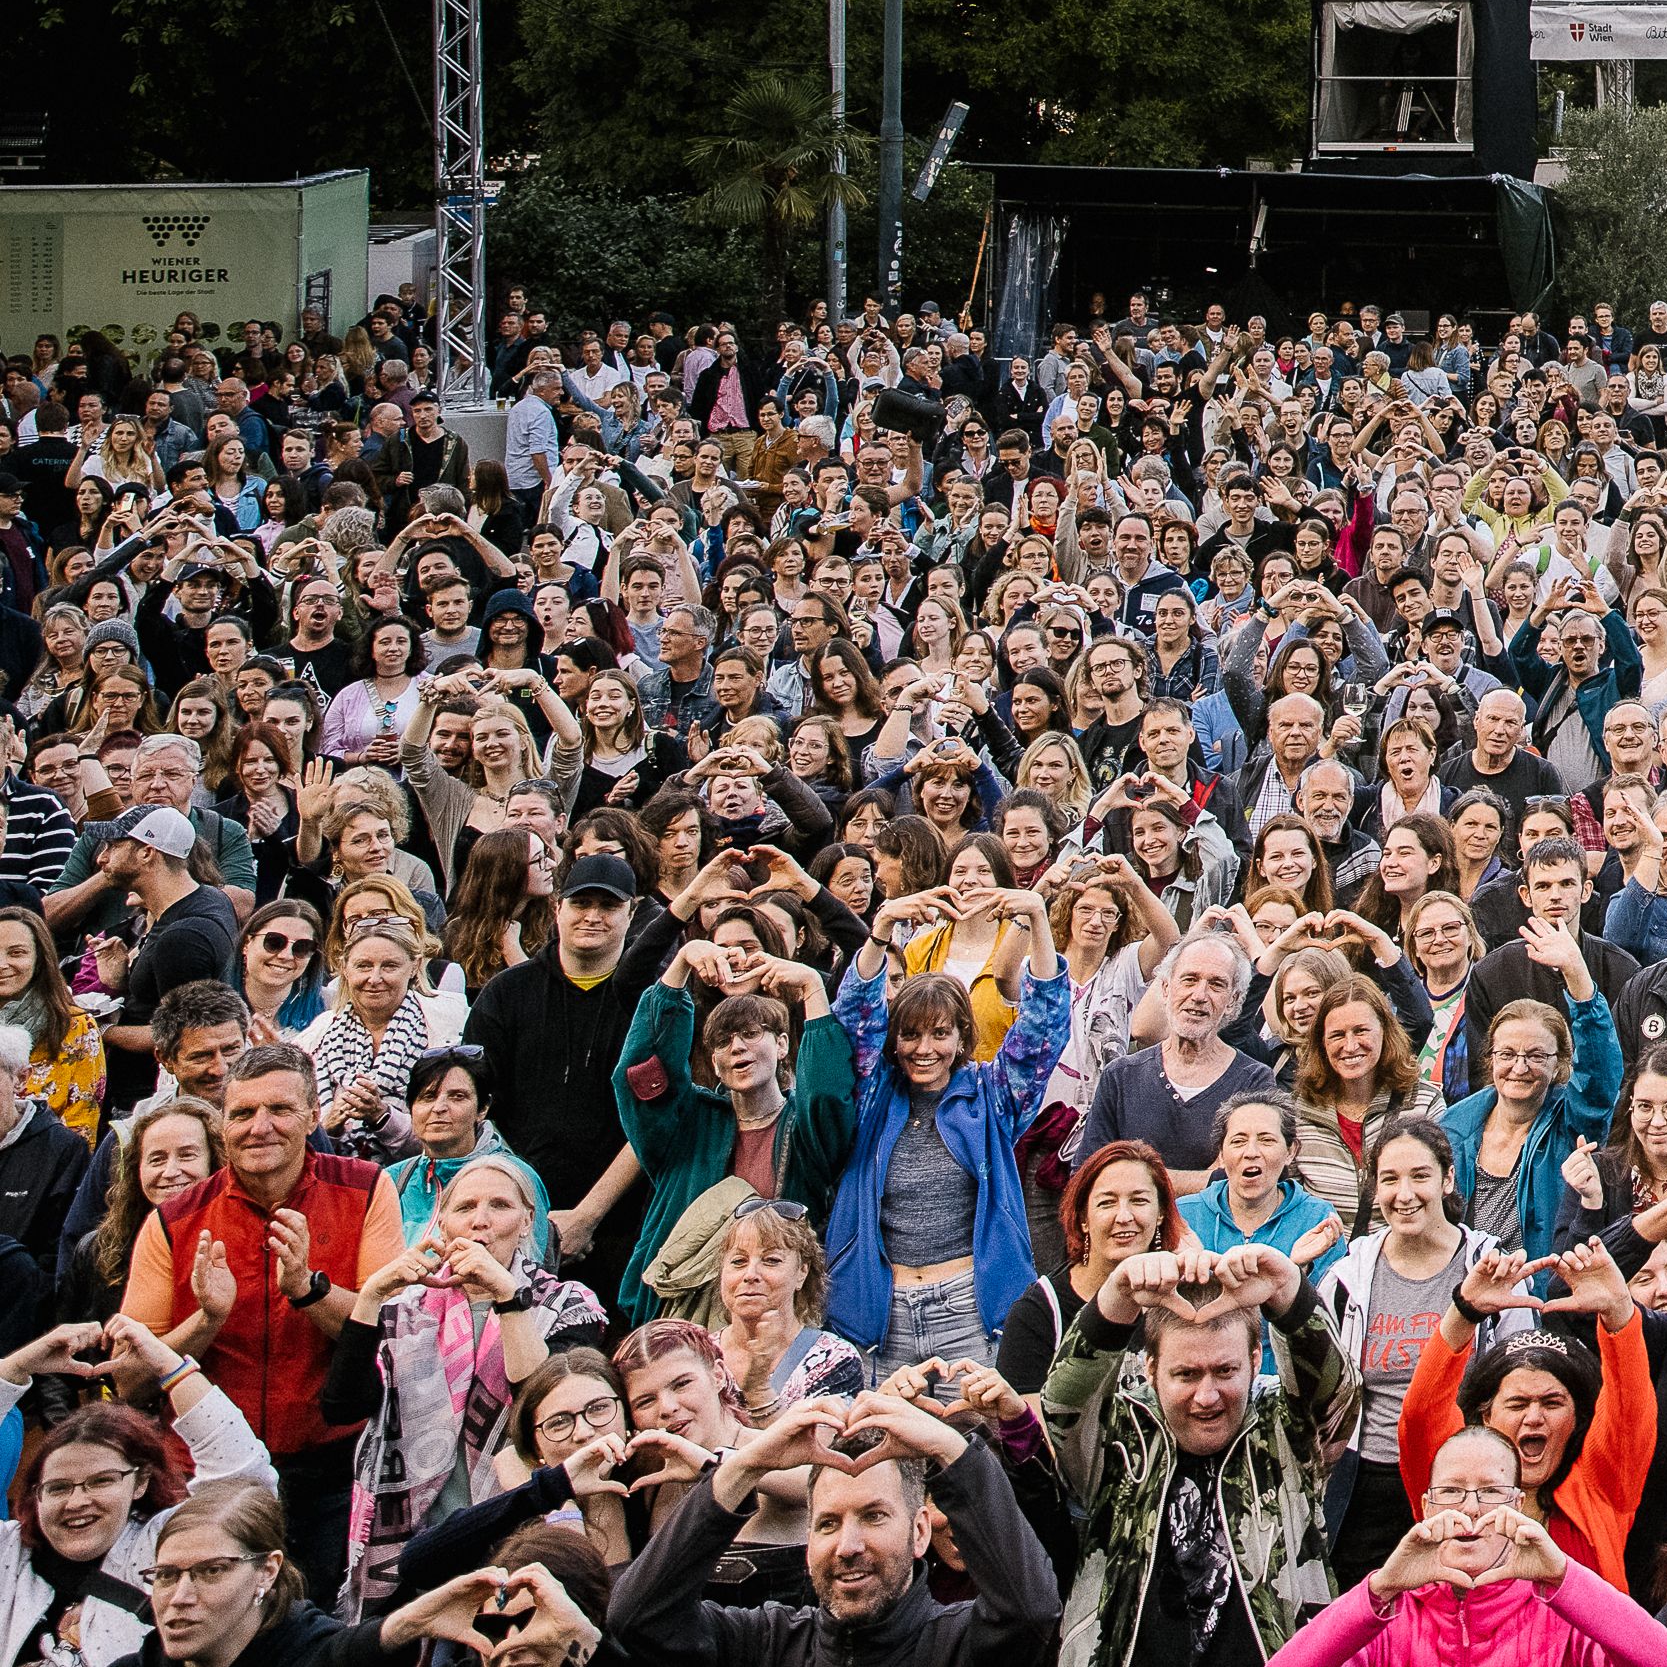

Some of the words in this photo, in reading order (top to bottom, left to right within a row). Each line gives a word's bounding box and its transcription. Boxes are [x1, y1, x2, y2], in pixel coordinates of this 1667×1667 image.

[1589, 23, 1612, 32] Stadt
[1589, 34, 1614, 42] Wien
[151, 257, 200, 266] WIENER
[122, 269, 229, 284] HEURIGER
